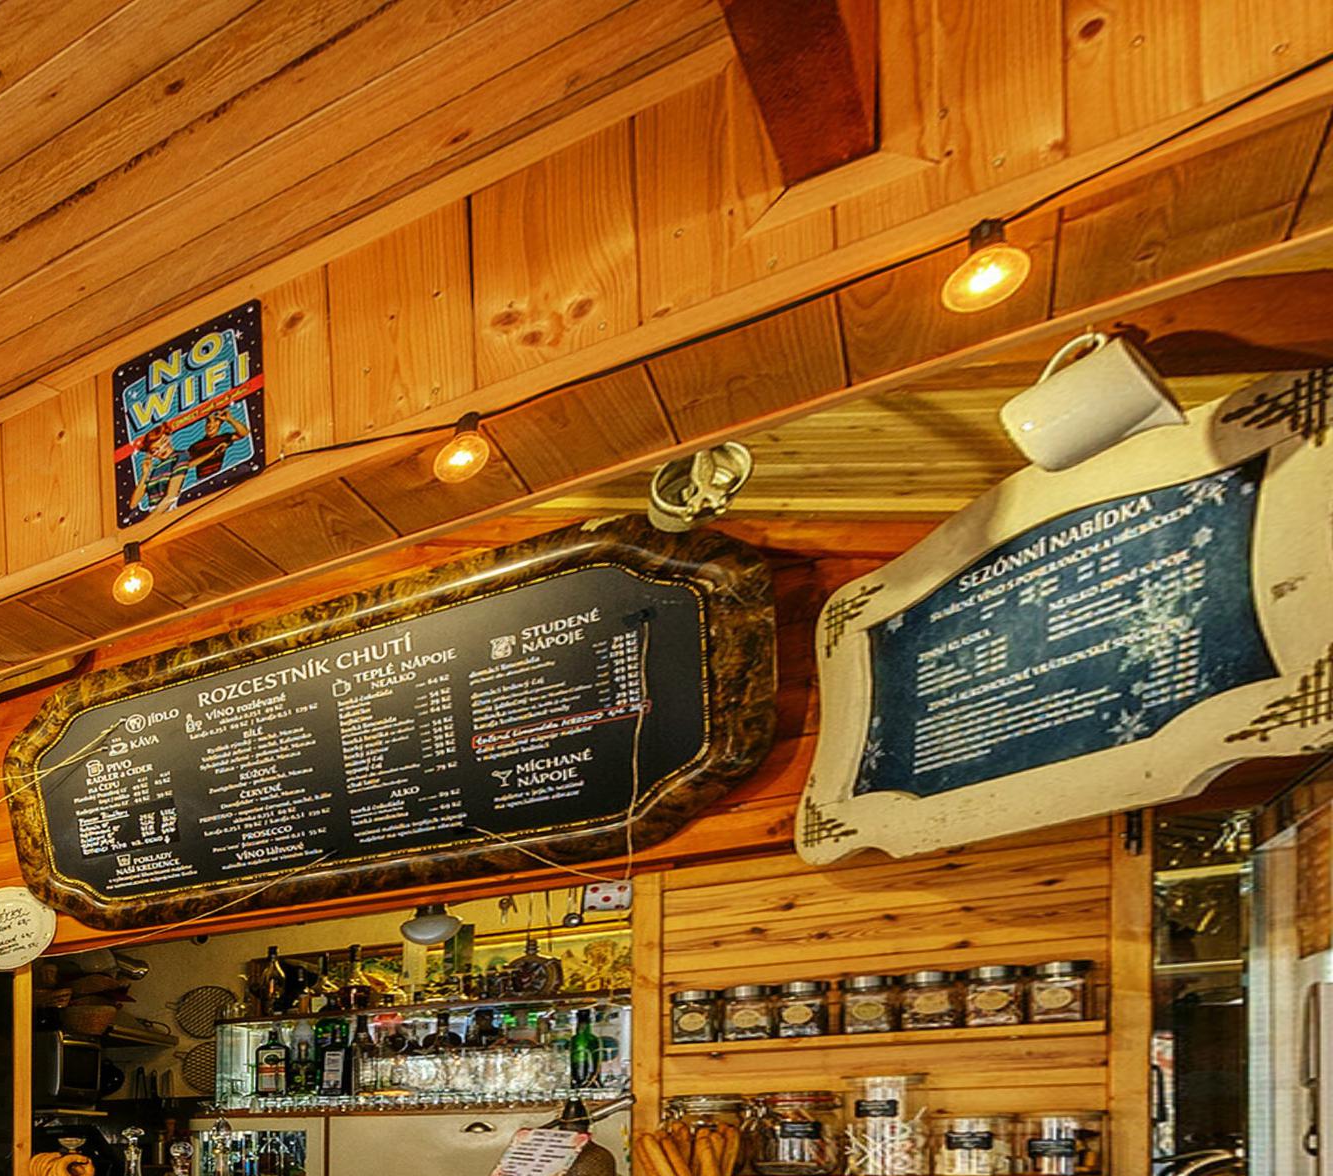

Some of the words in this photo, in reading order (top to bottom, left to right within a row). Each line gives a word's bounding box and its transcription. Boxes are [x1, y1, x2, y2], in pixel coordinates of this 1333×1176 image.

[149, 332, 223, 390] NO
[132, 351, 250, 430] WIFI
[957, 536, 1048, 593] SEZÓNNÍ
[1048, 496, 1153, 553] NABÍDKA
[520, 607, 602, 641] STUDENÉ
[522, 628, 585, 654] NÁPOJE
[197, 656, 331, 708] ROZCESTNÍK
[336, 632, 413, 670] CHUTÍ
[353, 664, 395, 684] TEPLÉ
[401, 648, 457, 671] NÁPOJE
[371, 672, 417, 689] NEALKO
[148, 708, 180, 727] JÍDLO
[205, 706, 235, 721] VÍNO
[236, 692, 287, 713] rozlévané
[130, 735, 159, 750] KÁVA
[107, 760, 132, 773] PIVO
[516, 748, 594, 775] MÍCHANÉ
[86, 772, 119, 786] RADLER
[126, 764, 154, 777] CIDER
[517, 767, 579, 788] NÁPOJE
[390, 785, 420, 799] ALKO
[242, 825, 293, 841] PROSECCO
[134, 852, 172, 865] POKLADY
[236, 848, 265, 861] VÍNO
